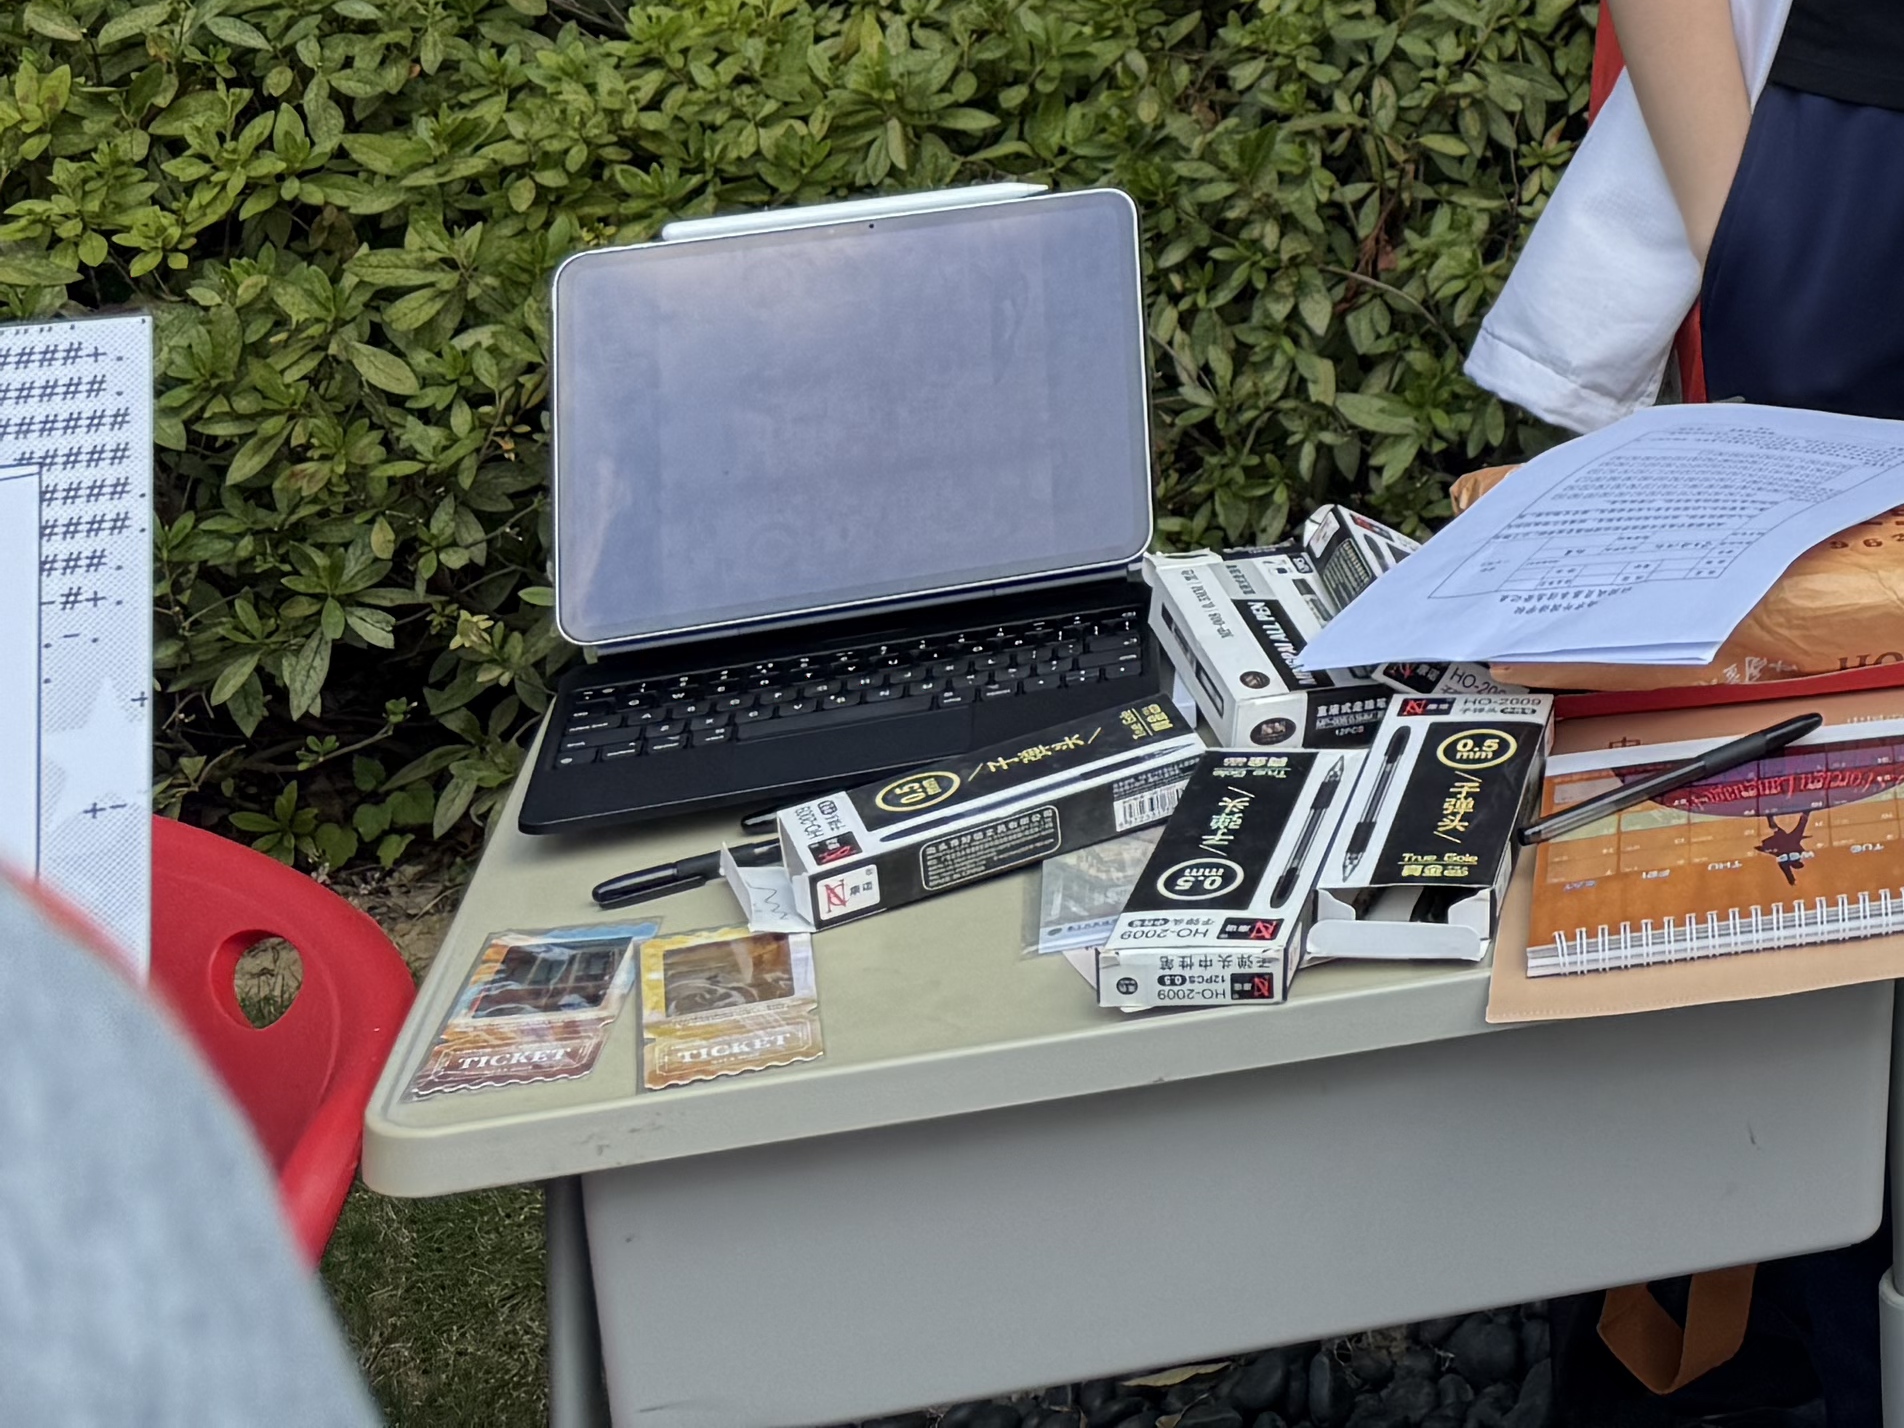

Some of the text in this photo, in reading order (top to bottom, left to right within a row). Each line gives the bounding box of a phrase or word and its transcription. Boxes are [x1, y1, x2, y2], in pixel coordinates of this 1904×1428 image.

[1463, 697, 1542, 706] HO-2009
[1456, 738, 1500, 752] 0.5
[987, 732, 1086, 773] 子弹头
[1455, 750, 1494, 760] mm
[894, 783, 925, 805] 0.5
[1437, 781, 1481, 832] 子弹头
[1201, 796, 1250, 845] 子弹头
[1184, 867, 1225, 877] mm
[1707, 859, 1744, 871] THU
[1174, 876, 1224, 891] 0.5
[1120, 926, 1210, 940] HO-2009
[1159, 954, 1273, 971] 子弹头中性笔
[1163, 975, 1226, 985] 12PCS 0.5
[1157, 988, 1227, 1001] HO-2009
[676, 1032, 792, 1063] TICKET
[456, 1046, 574, 1070] TICKET
